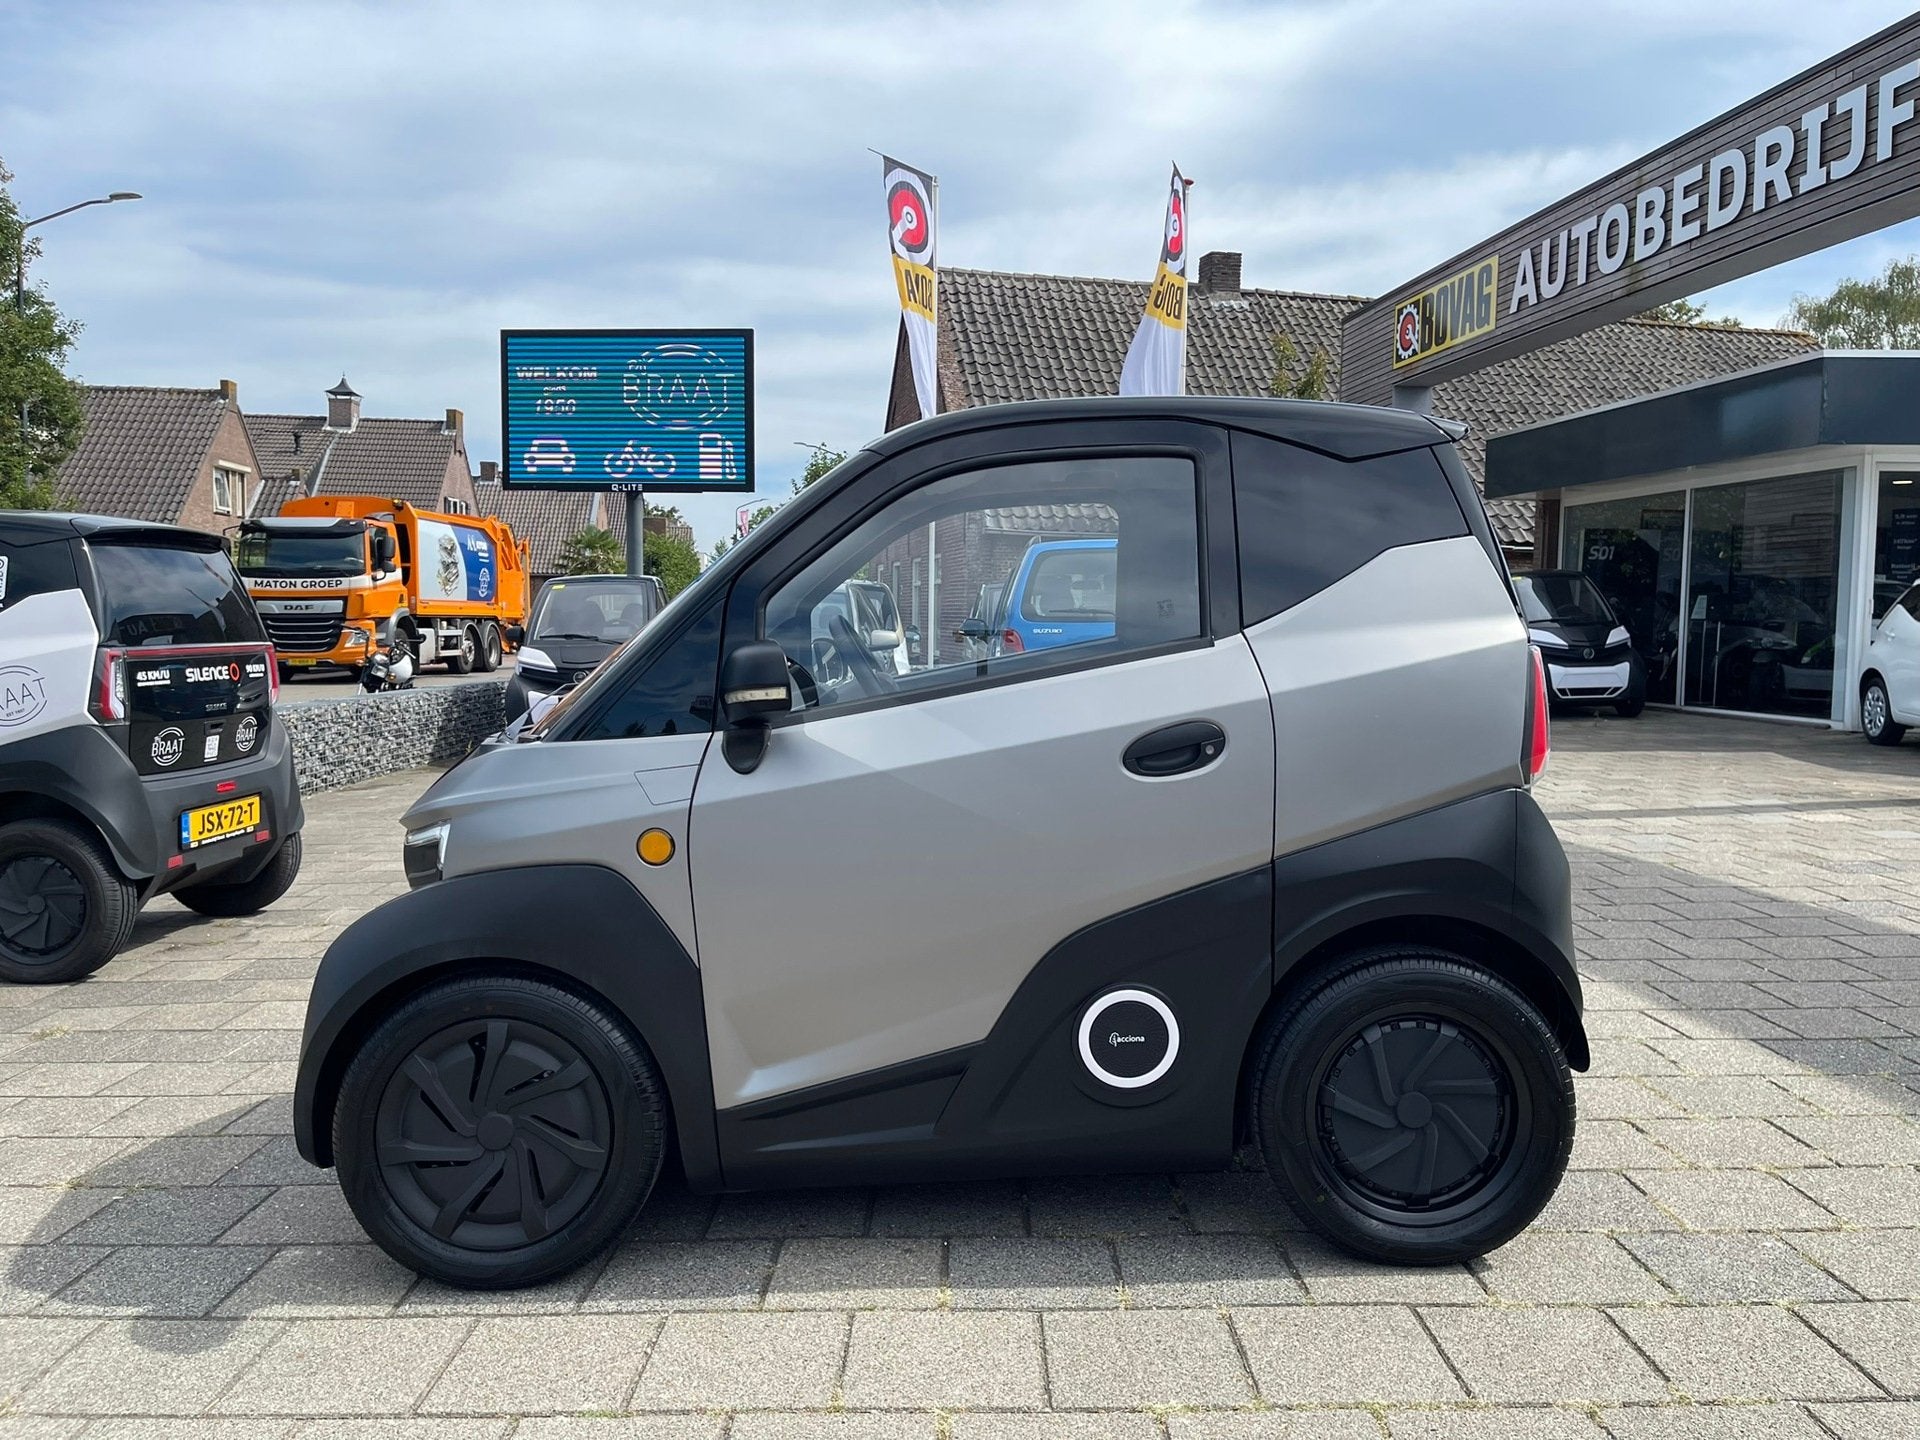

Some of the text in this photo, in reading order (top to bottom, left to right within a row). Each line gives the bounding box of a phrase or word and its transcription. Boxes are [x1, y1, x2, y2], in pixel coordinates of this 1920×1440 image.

[1508, 58, 1920, 315] AUTOBEDRIJF
[1420, 263, 1493, 354] BOVAG
[515, 366, 598, 381] WELKOM
[623, 373, 736, 404] BRAAT
[1588, 545, 1615, 560] S01
[254, 579, 343, 589] MATON GROEP
[136, 669, 170, 681] 45 KM/U
[185, 665, 230, 682] SILENCE
[0, 677, 46, 710] AAT
[236, 726, 258, 742] BRAAT
[152, 737, 185, 757] BRAAT
[198, 802, 255, 836] JSX-72-T
